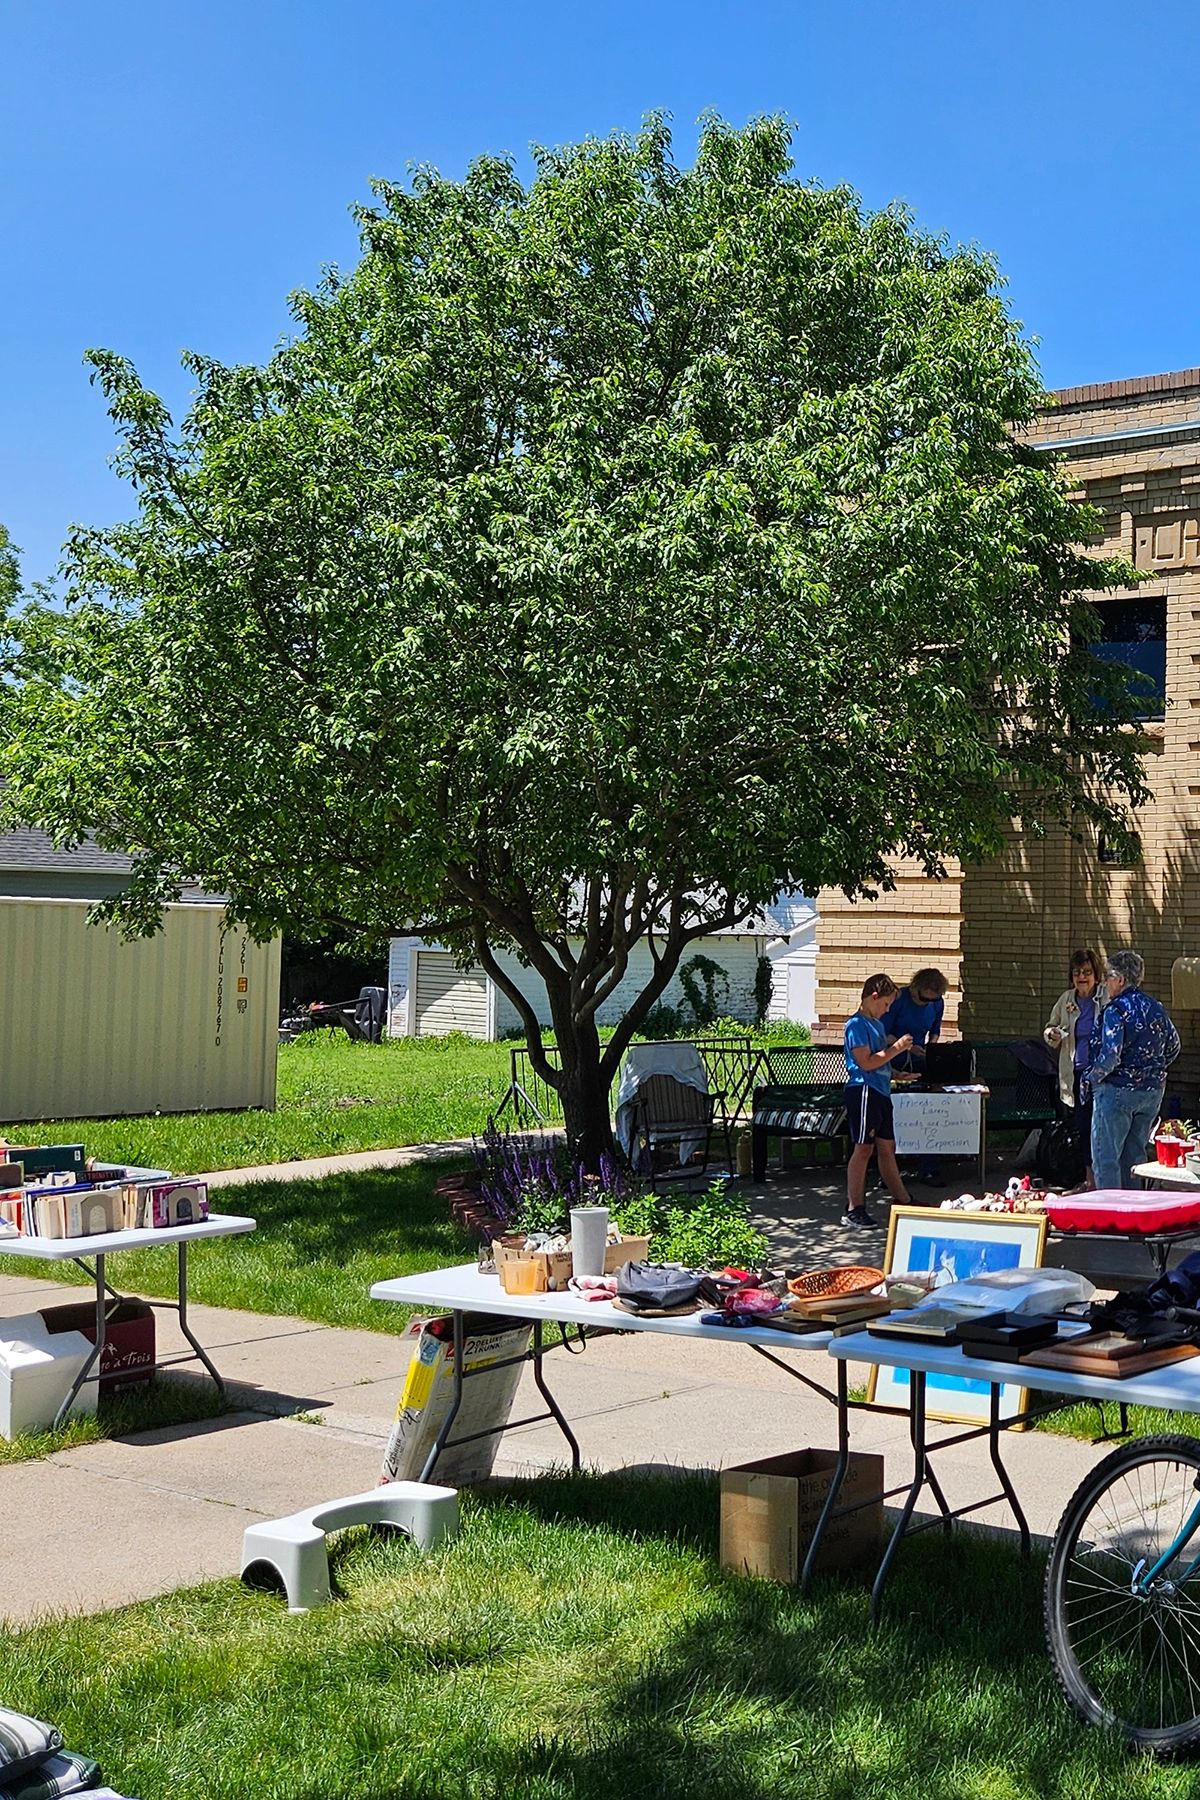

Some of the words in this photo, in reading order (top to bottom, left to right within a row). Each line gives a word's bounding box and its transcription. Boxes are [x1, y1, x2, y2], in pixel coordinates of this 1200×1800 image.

[900, 1096, 933, 1108] Friends
[465, 1340, 476, 1355] 2
[123, 1351, 151, 1366] Trois
[802, 1480, 820, 1495] the
